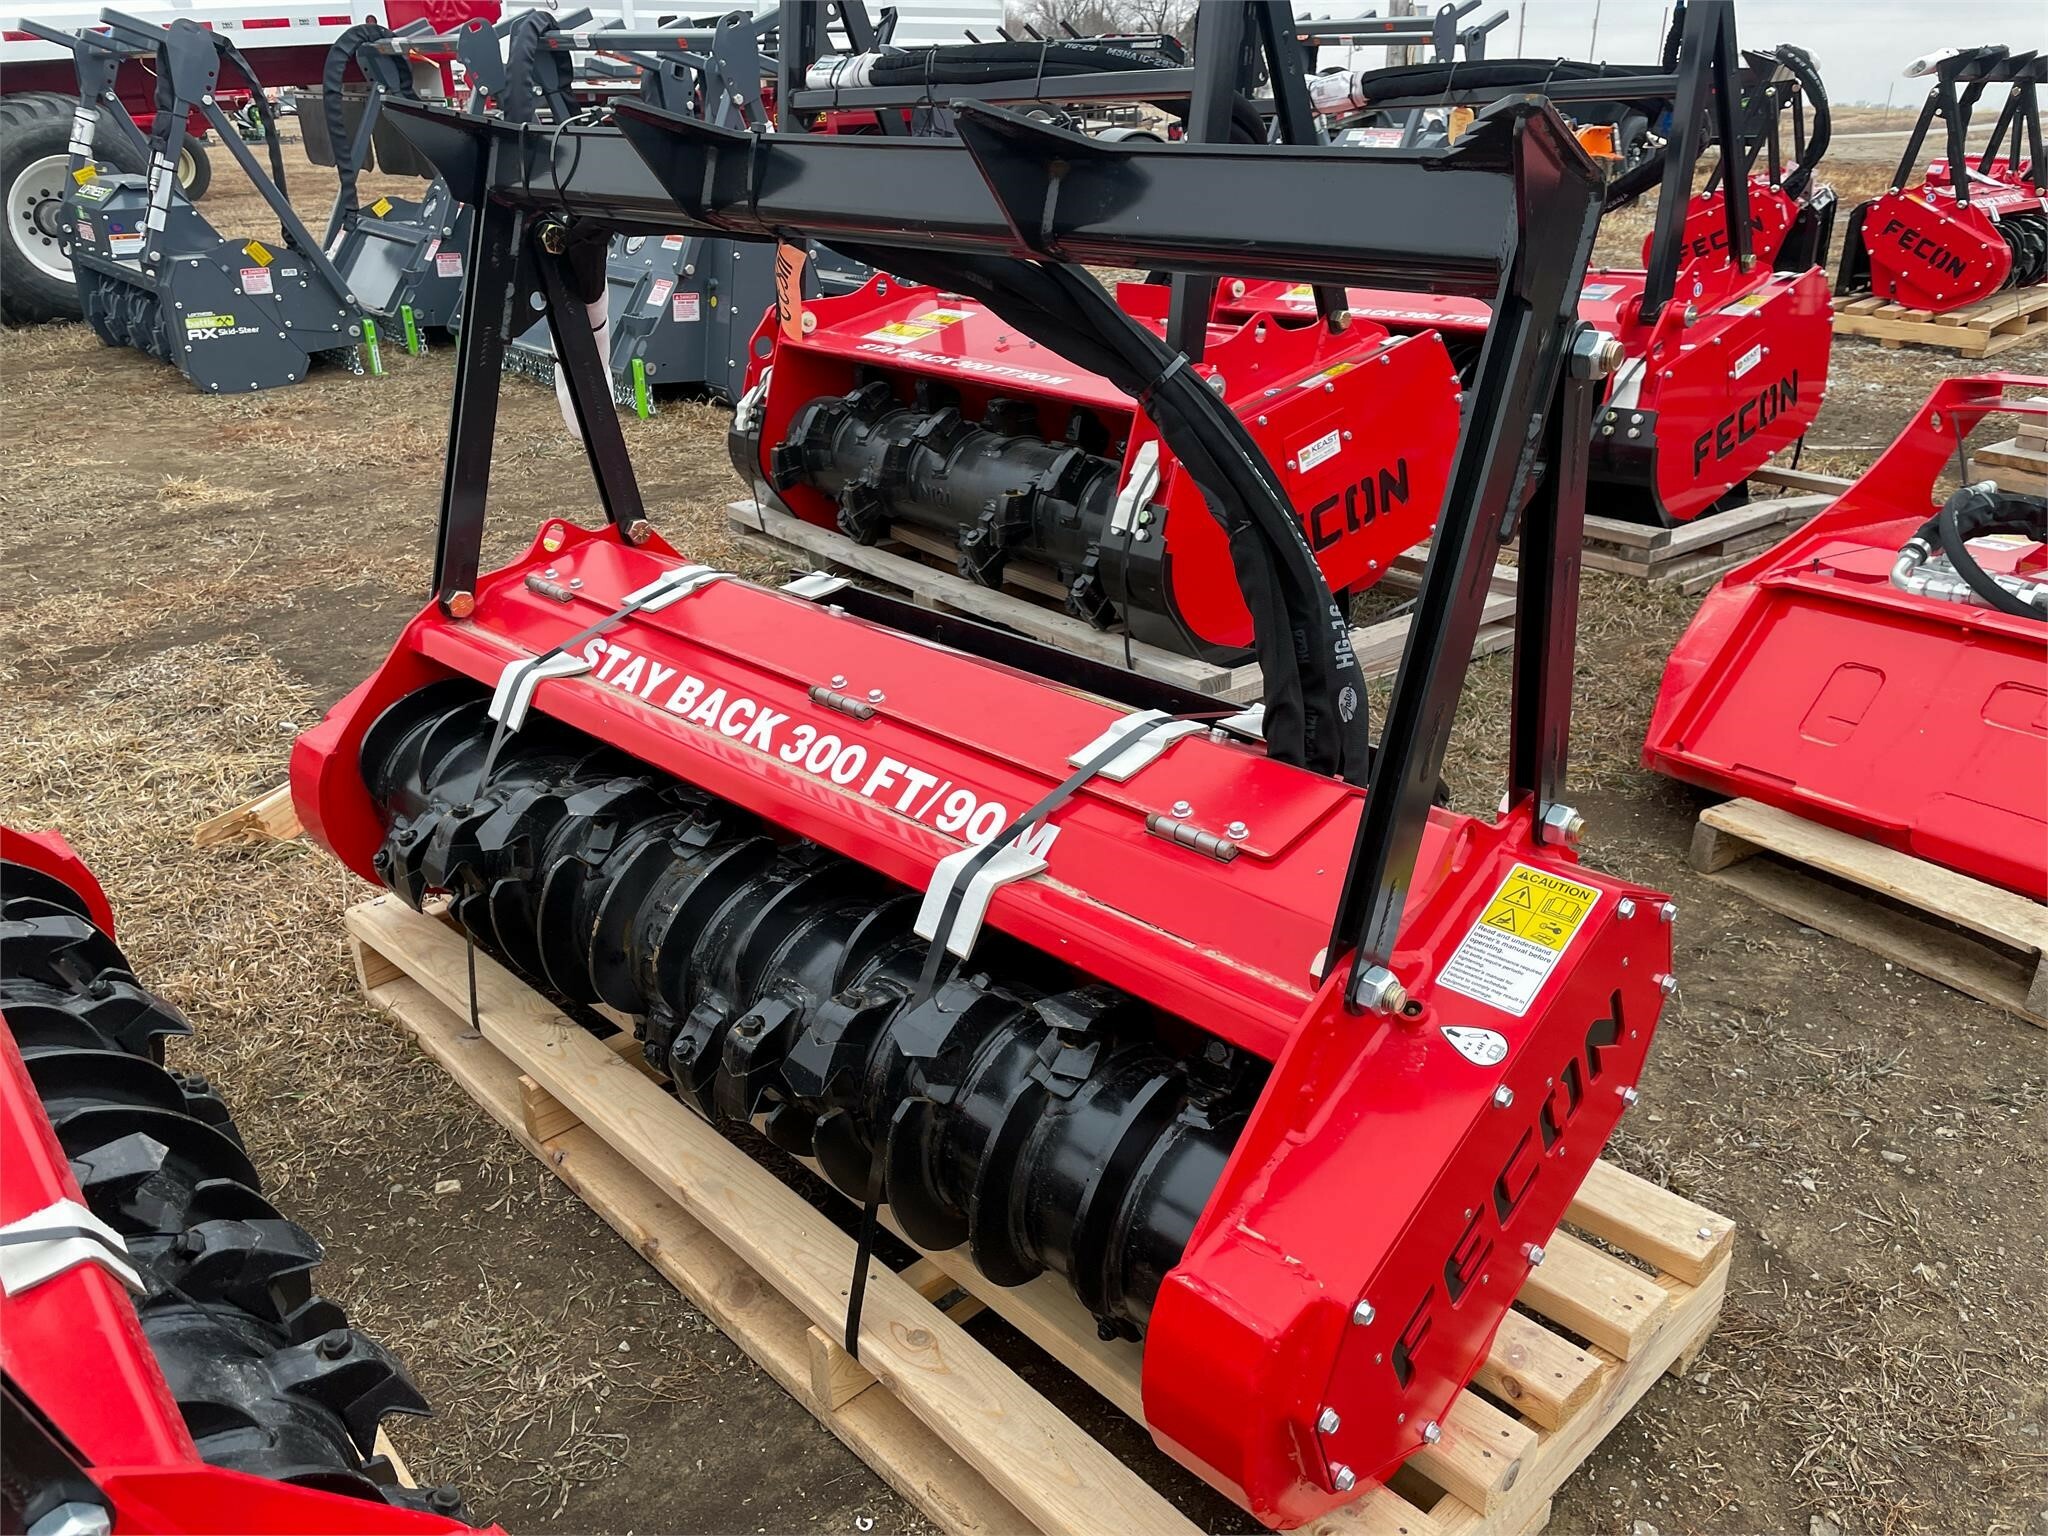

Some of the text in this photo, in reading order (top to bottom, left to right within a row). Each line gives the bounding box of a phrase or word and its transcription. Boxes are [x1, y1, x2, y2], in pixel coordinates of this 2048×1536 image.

[1882, 219, 1967, 279] FECON
[218, 326, 259, 336] Skid-Steer
[856, 343, 911, 355] STAY
[897, 351, 960, 365] BACK
[951, 360, 994, 371] 300
[1693, 368, 1798, 478] FECON
[1311, 432, 1337, 452] KEAST
[1297, 457, 1409, 554] CON
[582, 637, 677, 700] STAY
[664, 674, 791, 751] BACK
[780, 724, 869, 785] 300
[1529, 873, 1591, 901] CAUTION
[1469, 937, 1504, 954] operating.
[1474, 931, 1552, 964] owner's manual before
[1478, 924, 1552, 956] Read and understand
[1466, 944, 1486, 954] Periodic
[1487, 952, 1519, 967] maintenance
[1469, 952, 1482, 960] bolts
[1483, 957, 1502, 968] require
[1503, 965, 1524, 976] periodic
[1442, 977, 1471, 990] equipment
[1446, 971, 1464, 981] Failure
[1471, 981, 1490, 992] comply
[1491, 988, 1503, 996] may
[1503, 992, 1519, 1002] result
[1450, 966, 1483, 981] maintenance
[1464, 964, 1484, 974] owner's
[1485, 972, 1505, 983] manual
[1390, 987, 1626, 1390] FECON
